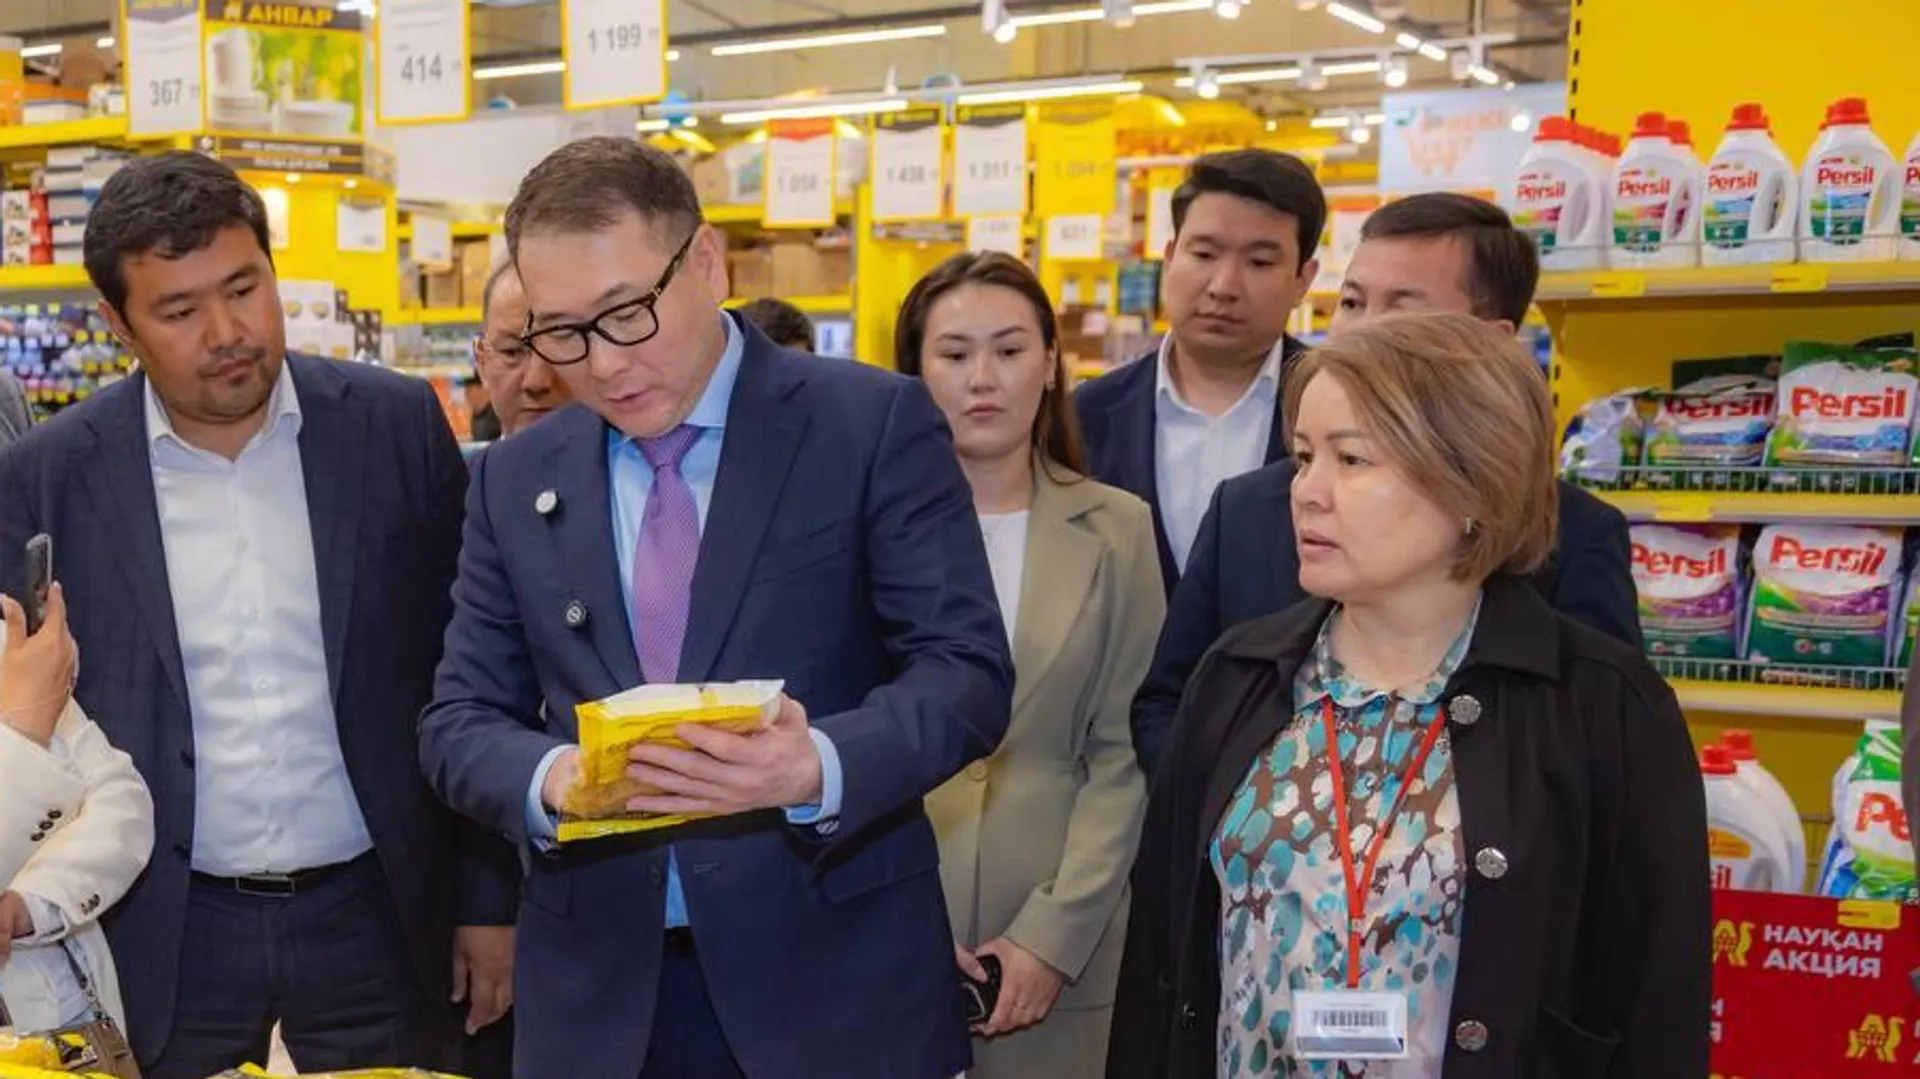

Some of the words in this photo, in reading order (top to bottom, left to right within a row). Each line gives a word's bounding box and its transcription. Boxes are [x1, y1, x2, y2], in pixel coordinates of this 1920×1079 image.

[606, 23, 642, 51] 199
[401, 53, 442, 84] 414
[149, 77, 183, 107] 367
[1517, 181, 1566, 199] Persil
[1618, 177, 1671, 197] Persil
[1709, 170, 1759, 190] Persil
[1817, 167, 1875, 185] Persil
[1792, 386, 1907, 418] Persil
[1630, 542, 1726, 578] Persil
[1769, 534, 1887, 577] Persil
[1763, 923, 1884, 952] НАУҚАН
[1762, 948, 1882, 979] АКЦИЯ
